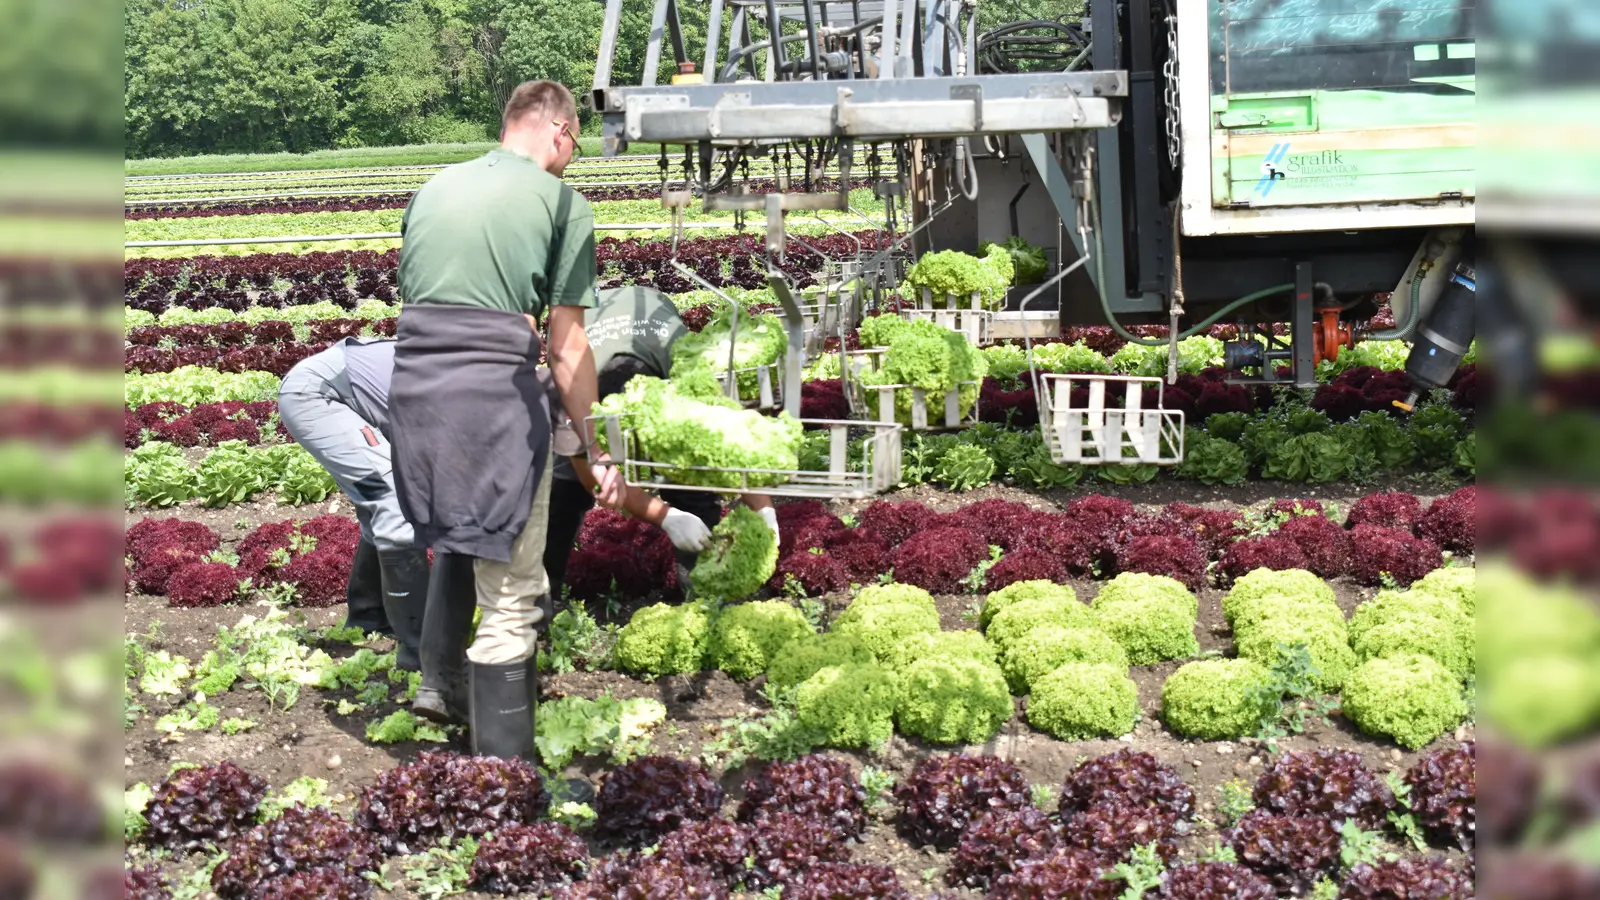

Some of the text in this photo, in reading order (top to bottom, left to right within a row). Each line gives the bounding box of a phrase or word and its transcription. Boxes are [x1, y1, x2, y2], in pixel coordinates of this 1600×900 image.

[1287, 149, 1343, 172] grafik
[1301, 164, 1358, 175] ILLUSTRATION
[633, 319, 649, 327] wir
[621, 327, 646, 337] kein
[588, 331, 619, 350] Probl
